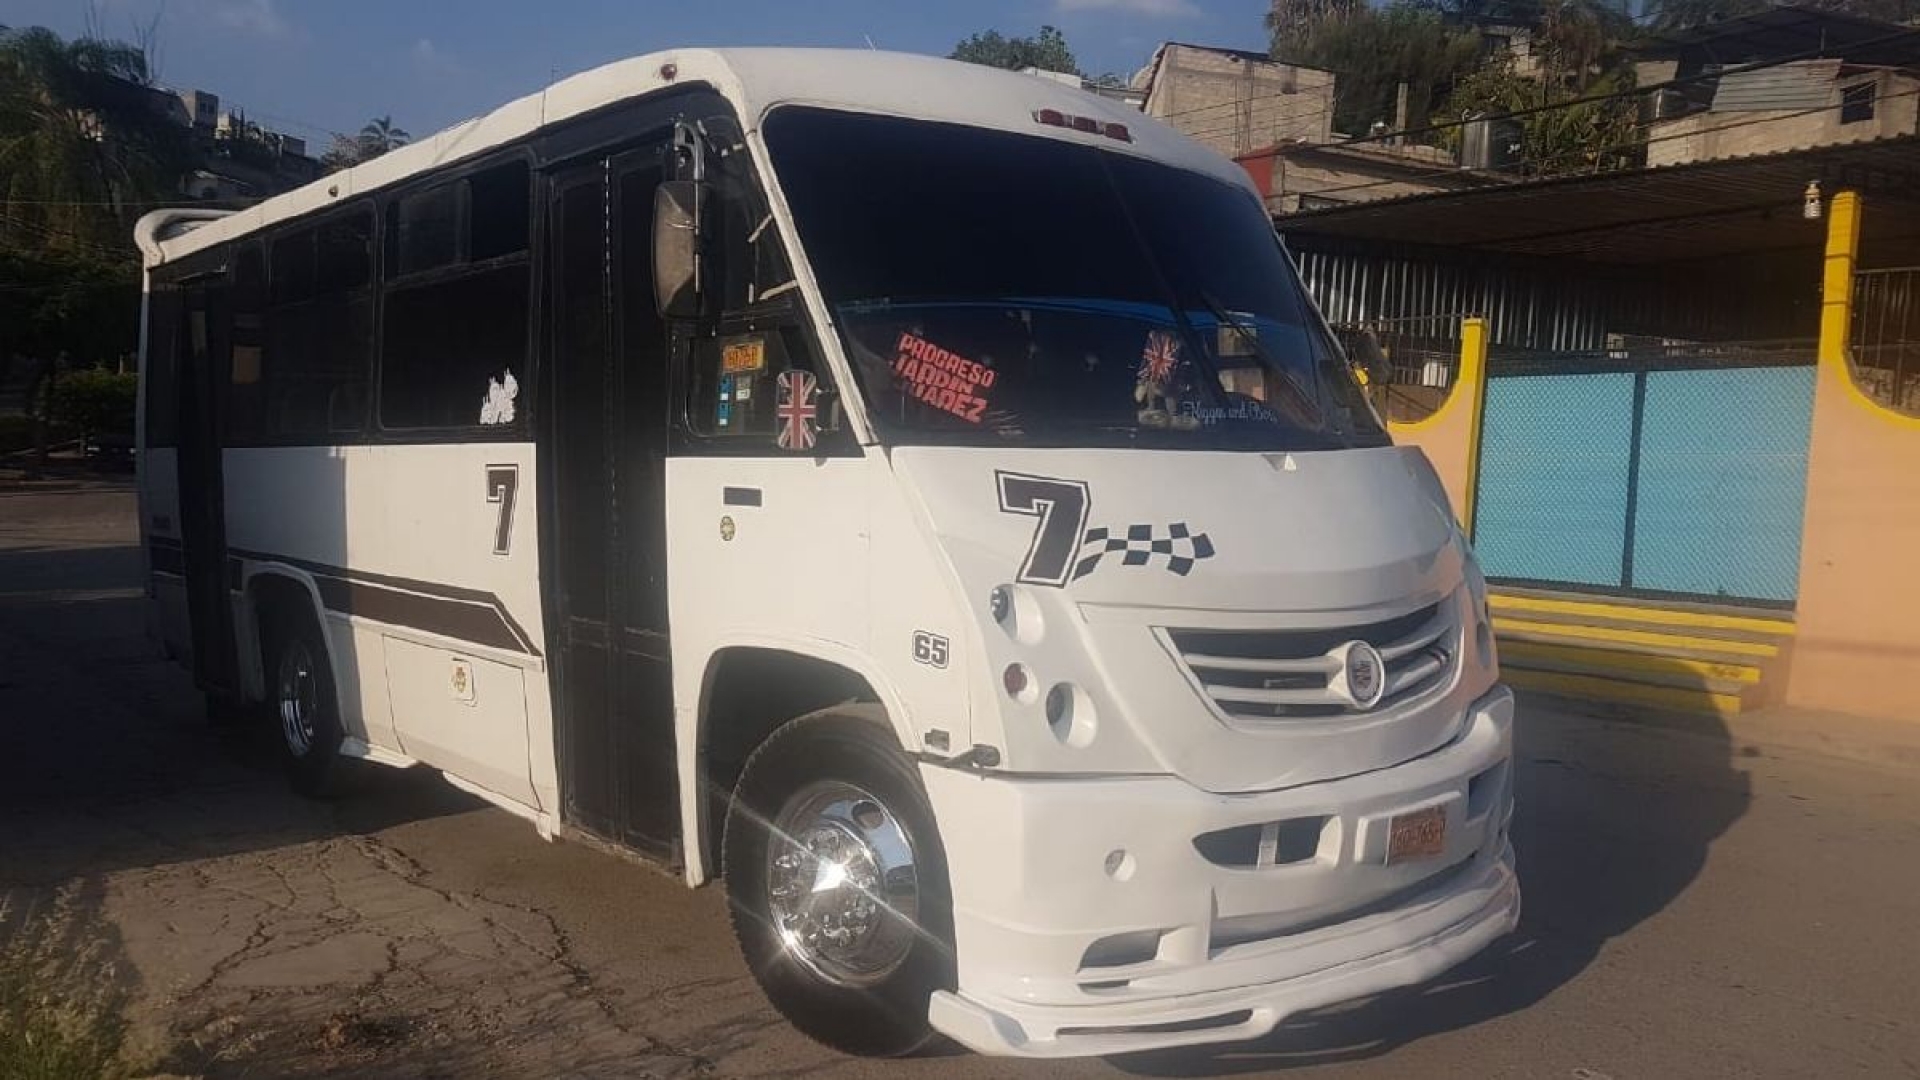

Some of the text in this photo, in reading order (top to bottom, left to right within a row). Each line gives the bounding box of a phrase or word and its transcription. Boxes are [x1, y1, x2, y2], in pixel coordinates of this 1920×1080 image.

[899, 332, 995, 388] PROGRESO
[485, 463, 519, 555] 7
[994, 469, 1092, 589] 7
[912, 629, 950, 670] 65
